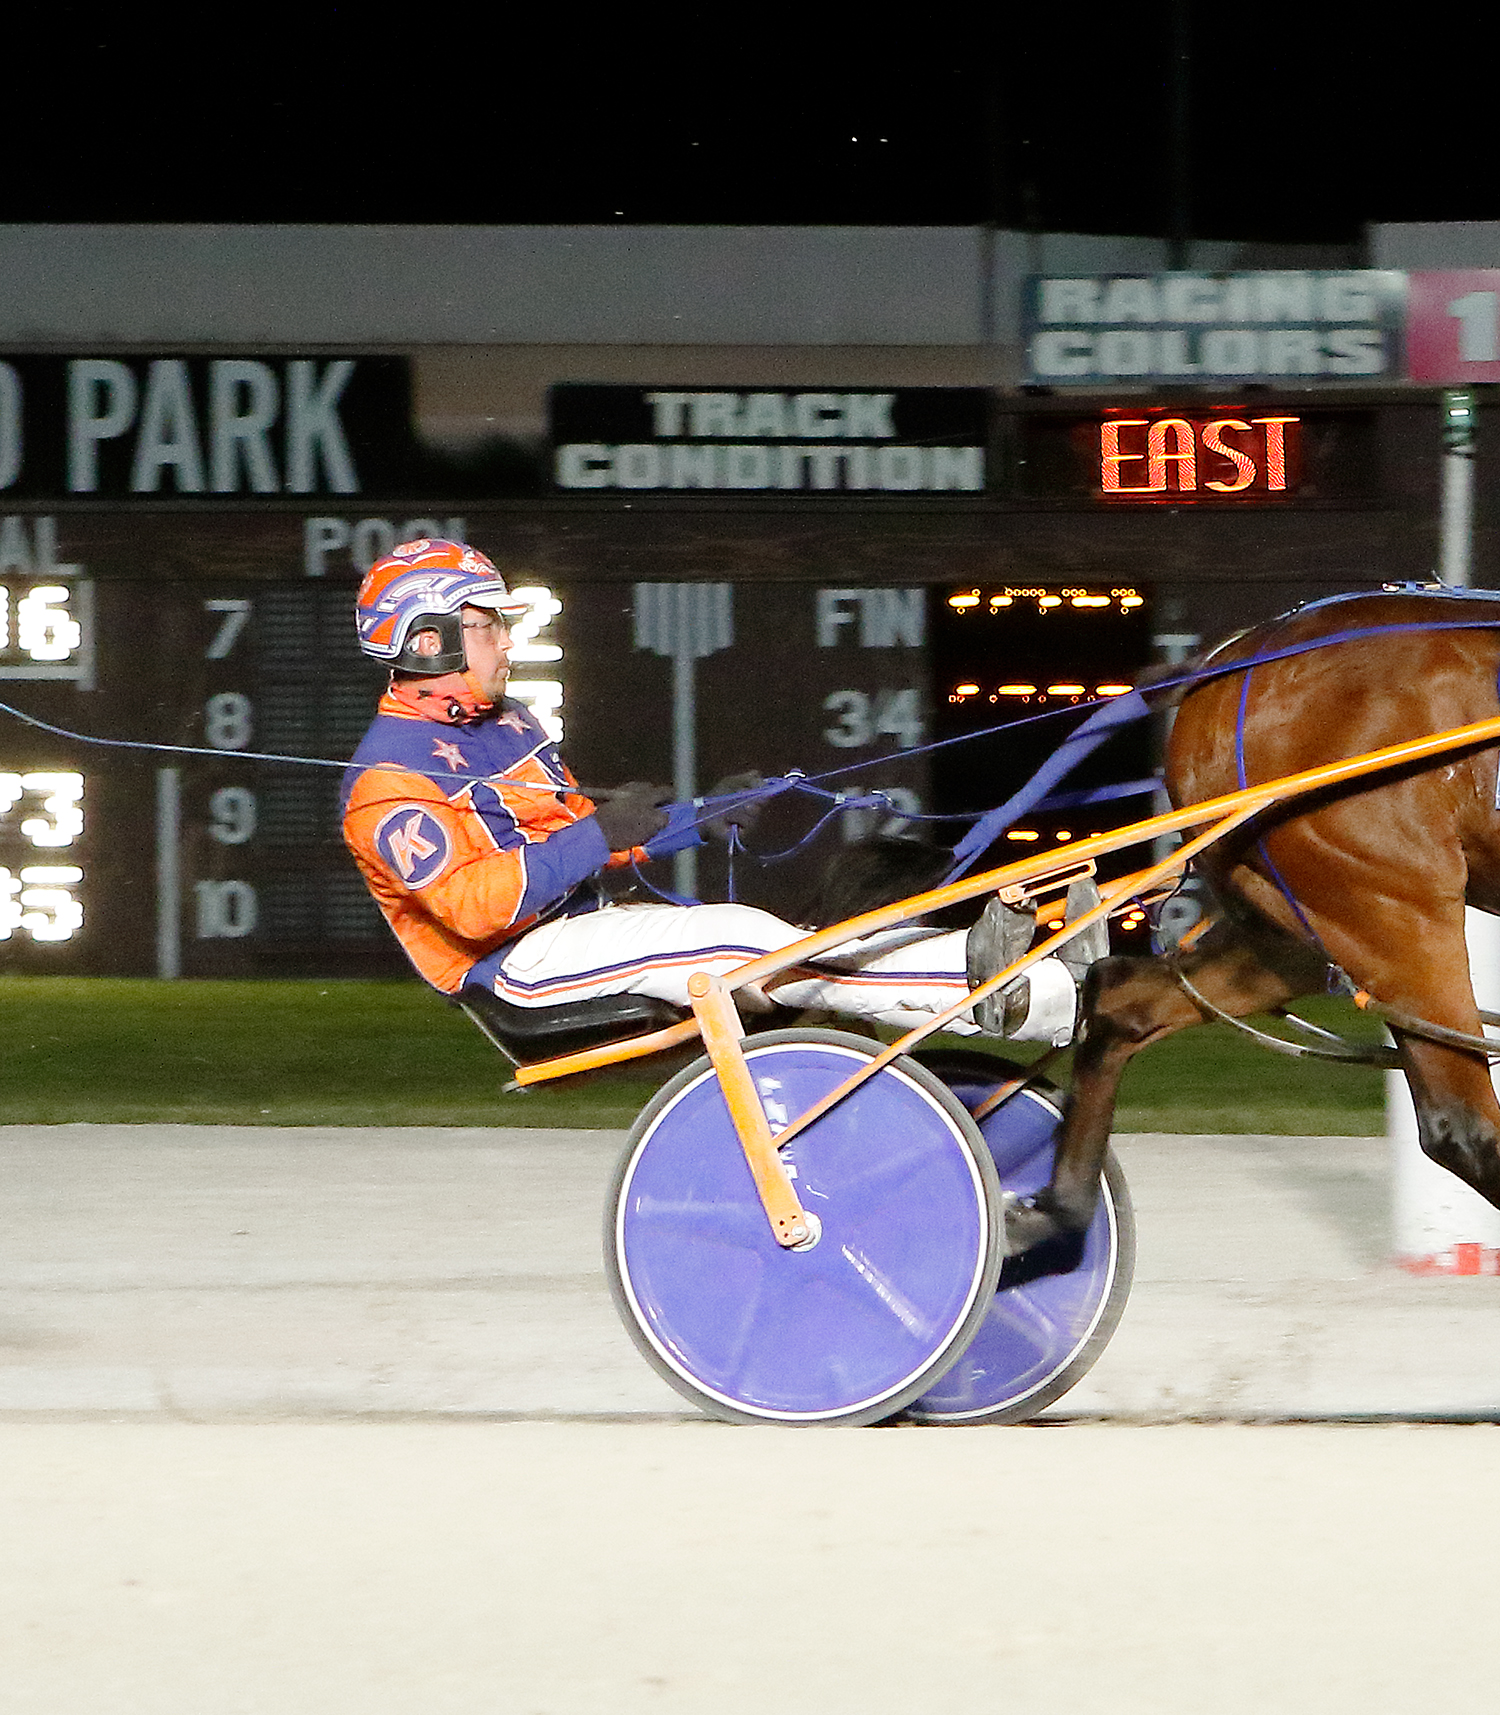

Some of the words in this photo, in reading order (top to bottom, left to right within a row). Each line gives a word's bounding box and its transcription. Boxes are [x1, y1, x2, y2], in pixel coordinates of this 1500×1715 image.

[1038, 275, 1382, 323] RACING
[1450, 290, 1500, 363] 1
[1032, 328, 1386, 376] COLORS
[65, 359, 361, 494] PARK
[643, 392, 898, 438] TRACK
[555, 443, 986, 490] CONDITION
[205, 599, 251, 661] 7
[206, 692, 252, 752] 8
[823, 689, 924, 749] 34
[208, 785, 257, 846] 9
[387, 811, 439, 881] K
[196, 880, 259, 939] 10
